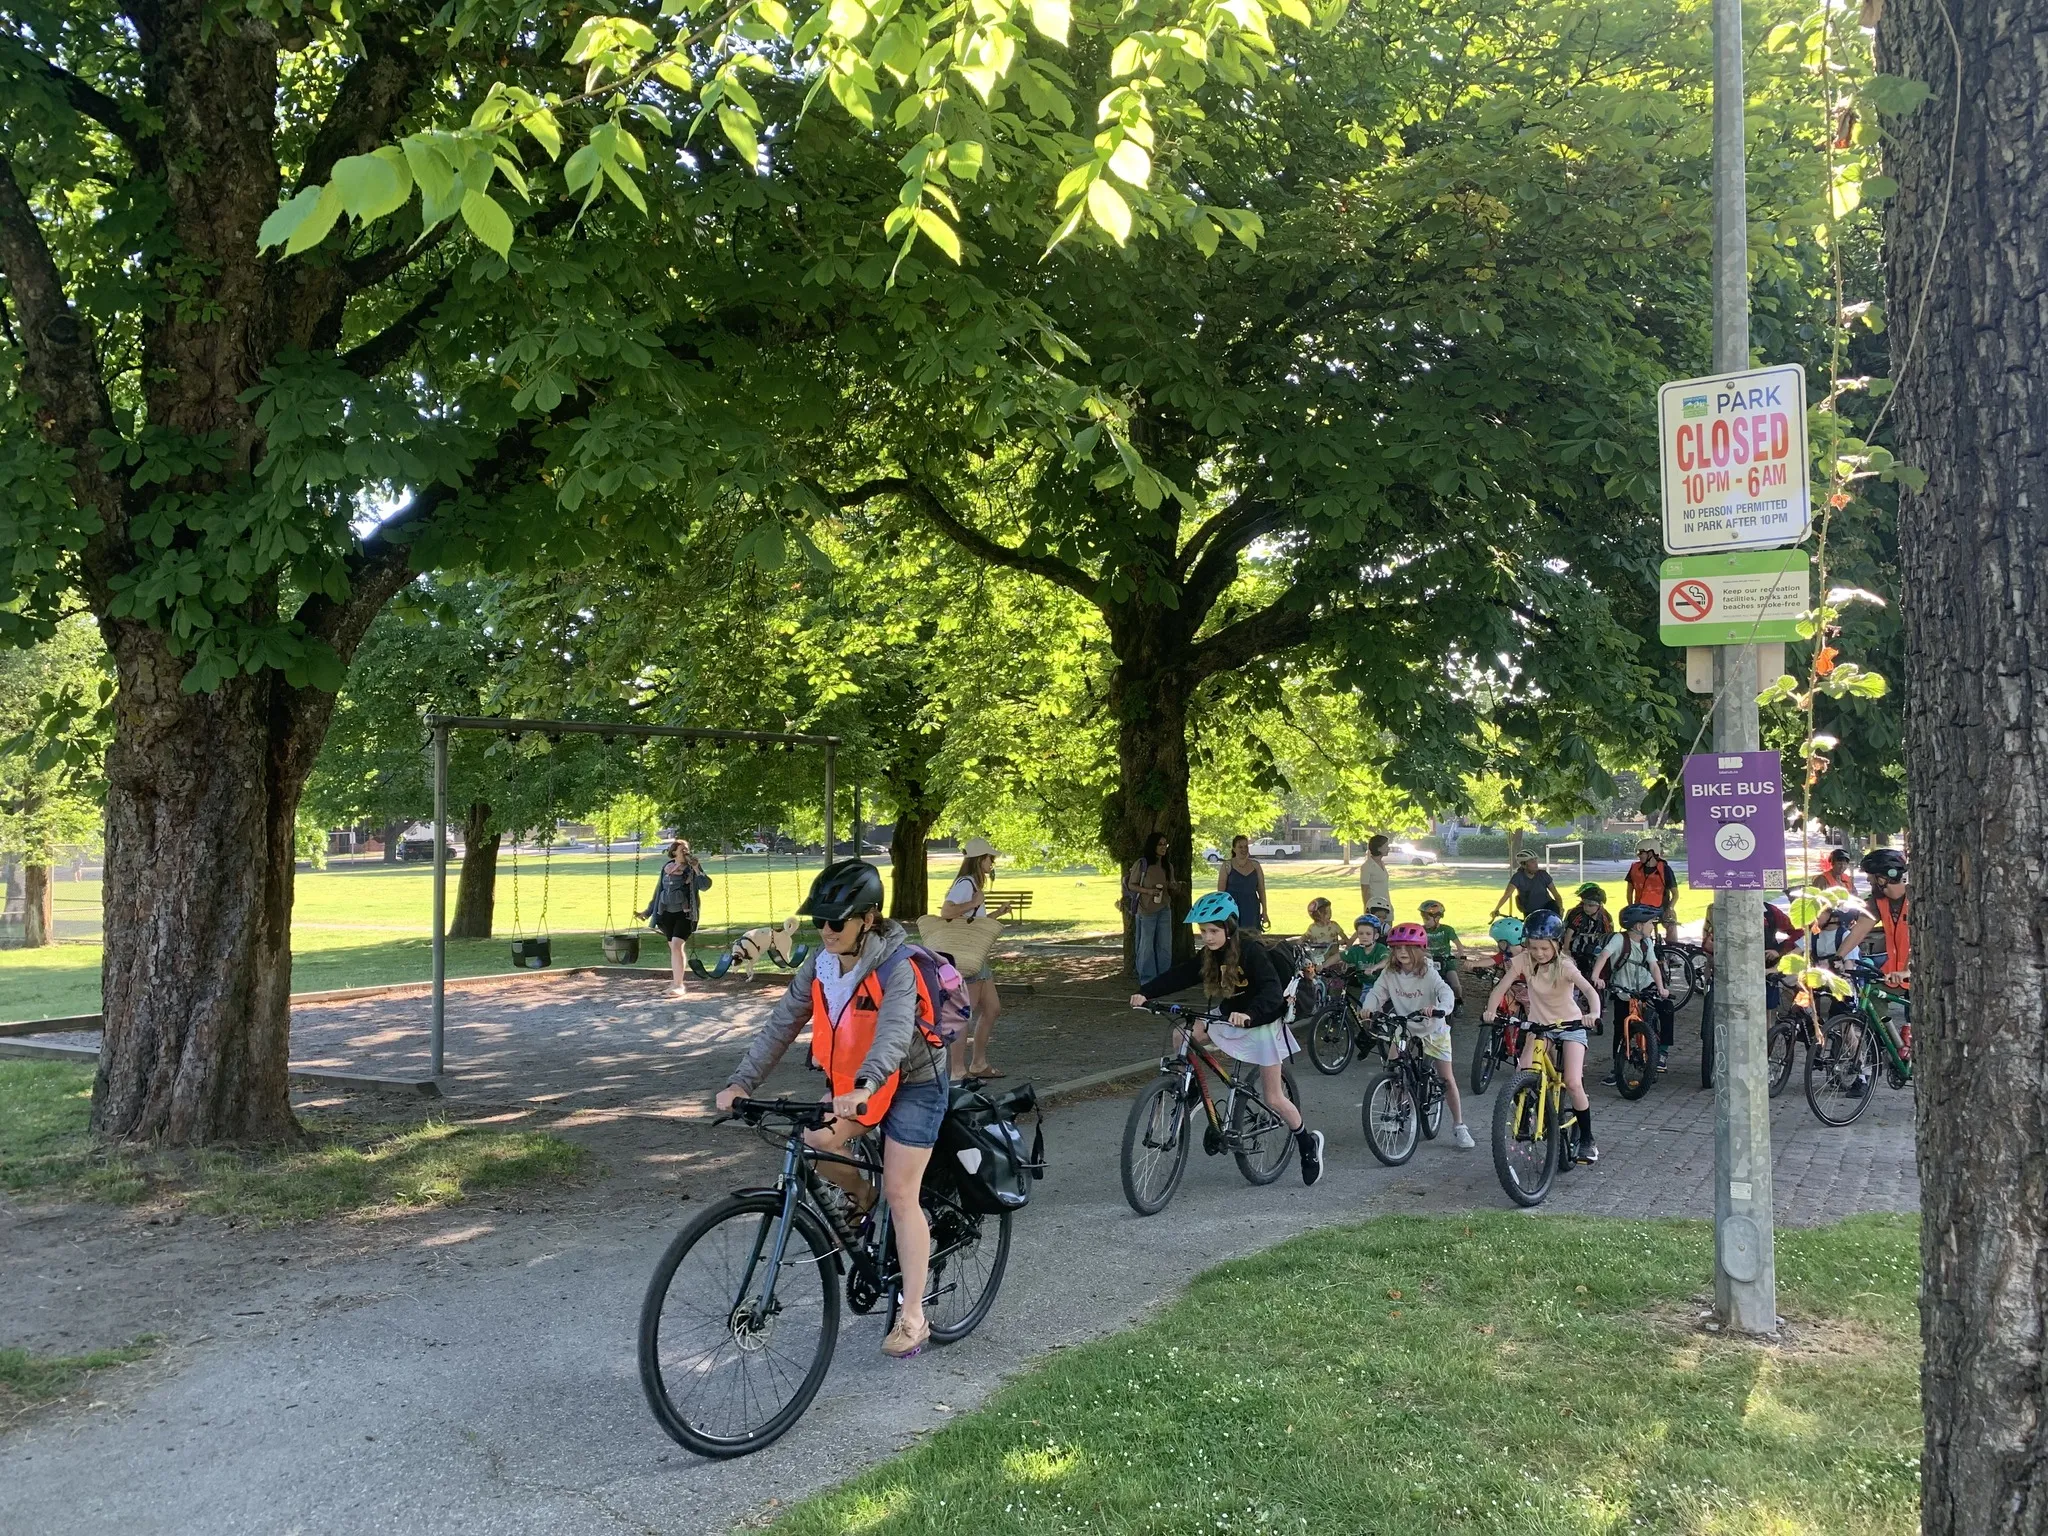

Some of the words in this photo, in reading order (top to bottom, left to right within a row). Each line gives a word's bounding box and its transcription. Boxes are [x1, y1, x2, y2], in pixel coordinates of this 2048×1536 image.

[1717, 385, 1781, 414] PARK
[1677, 413, 1789, 471] CLOSED
[1682, 471, 1730, 504] 10PM
[1748, 463, 1787, 498] 6AM
[1683, 508, 1696, 520] NO
[1698, 504, 1733, 518] PERSON
[1736, 499, 1787, 513] PERMITTED
[1684, 522, 1694, 533] IN
[1697, 519, 1723, 532] PARK
[1726, 516, 1757, 530] AFTER
[1723, 588, 1742, 596] Keep
[1760, 585, 1801, 594] receation
[1759, 594, 1781, 602] paks
[1691, 783, 1732, 797] BIKE
[1737, 781, 1775, 796] BUS
[1710, 805, 1758, 819] STOP
